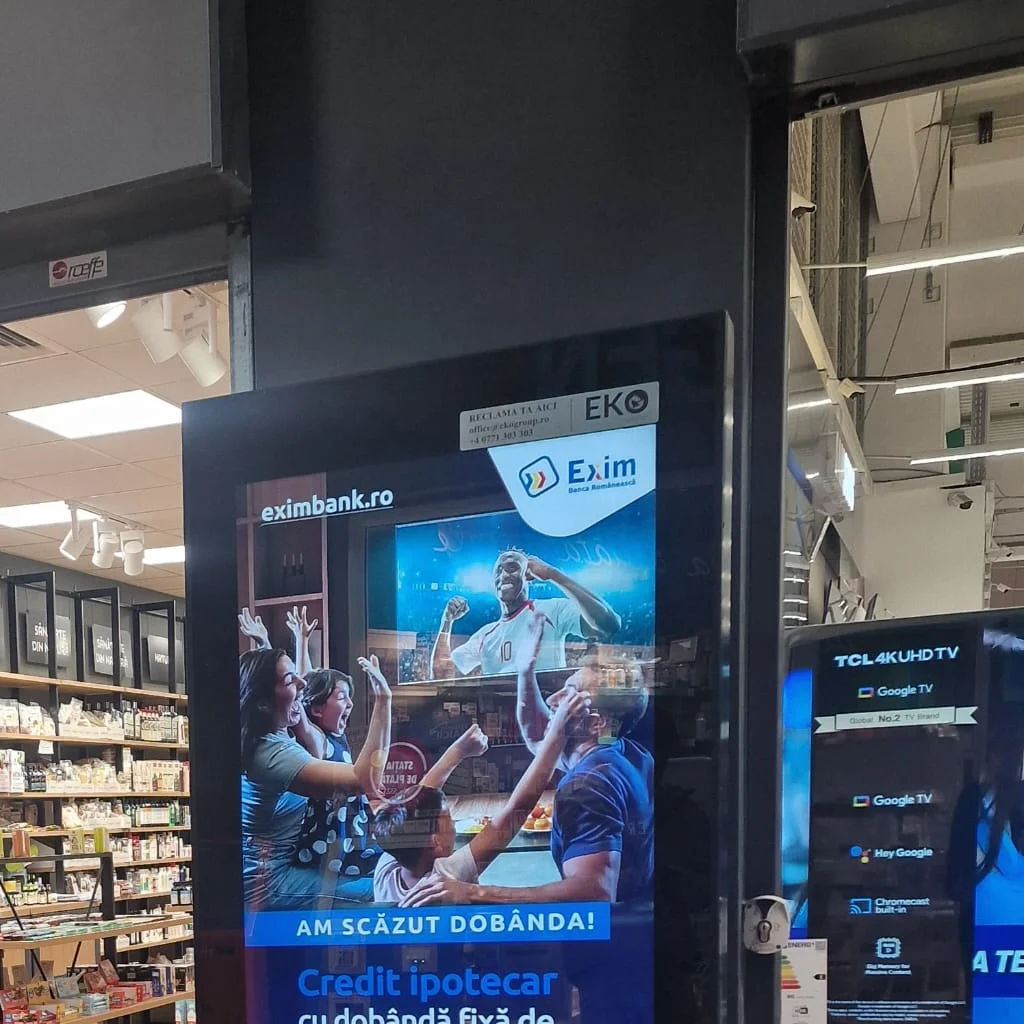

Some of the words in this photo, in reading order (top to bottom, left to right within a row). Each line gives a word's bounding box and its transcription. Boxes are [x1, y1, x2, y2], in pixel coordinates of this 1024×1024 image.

[585, 389, 649, 421] EKO
[568, 455, 636, 484] Exim
[261, 488, 394, 523] eximbank.ro
[877, 684, 917, 698] Google
[918, 683, 934, 693] TV
[873, 794, 915, 807] Google
[916, 793, 933, 804] TV
[875, 849, 894, 860] Hey
[896, 848, 933, 859] Google
[296, 919, 333, 937] AM
[341, 913, 440, 936] SCĂZUT
[450, 909, 595, 934] DOBÂNDA!
[298, 967, 401, 997] Credit
[409, 966, 558, 1002] ipotecar
